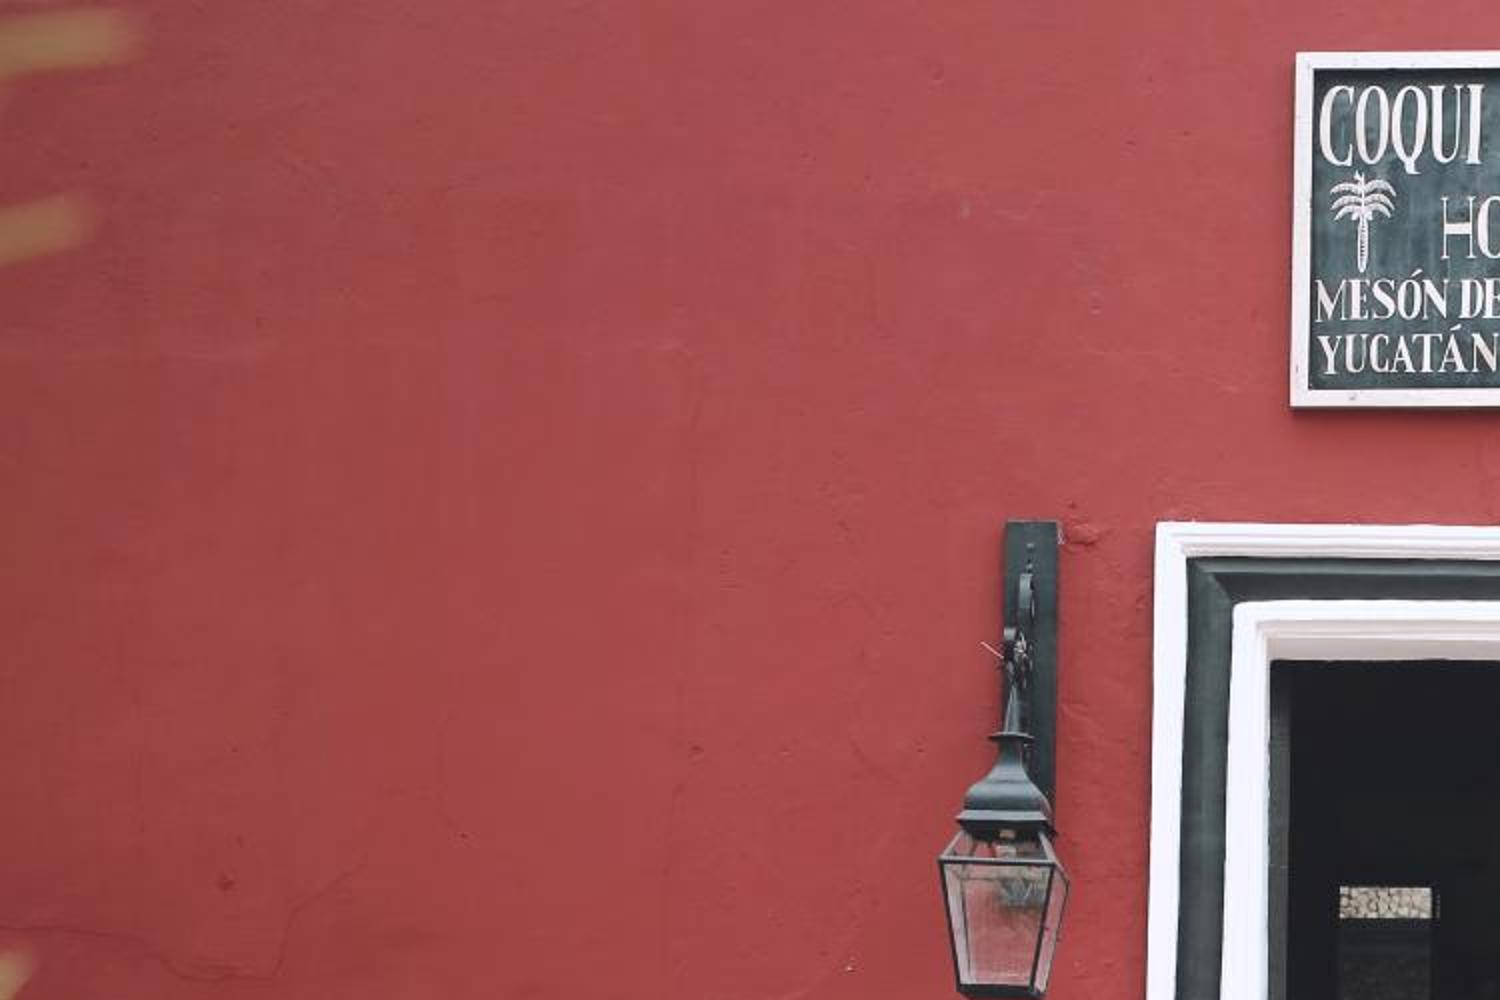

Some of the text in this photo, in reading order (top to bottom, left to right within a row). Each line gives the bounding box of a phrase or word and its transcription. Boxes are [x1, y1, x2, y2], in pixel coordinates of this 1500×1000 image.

[1319, 83, 1485, 174] COQUI
[1315, 270, 1449, 322] MESÓN
[1317, 325, 1499, 375] YUCATÁN
